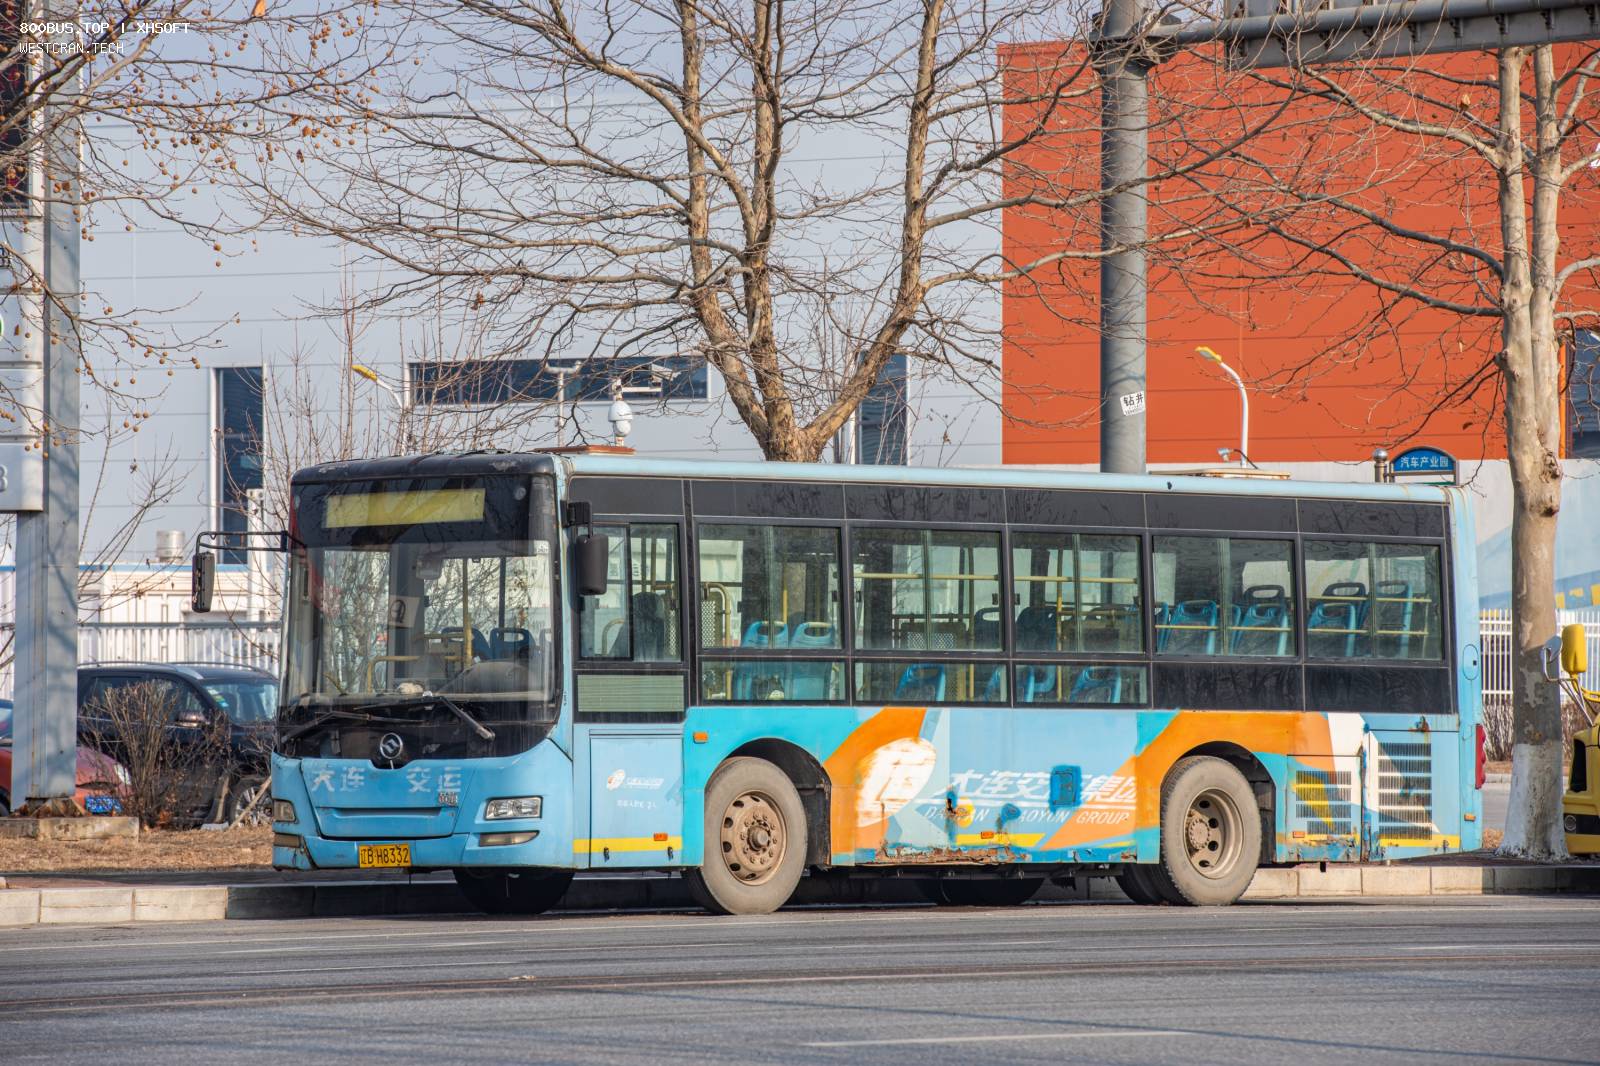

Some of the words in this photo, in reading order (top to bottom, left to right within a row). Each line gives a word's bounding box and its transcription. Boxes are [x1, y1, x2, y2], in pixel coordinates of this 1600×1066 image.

[1400, 456, 1449, 468] 汽车产业园
[1076, 811, 1130, 825] GROUP
